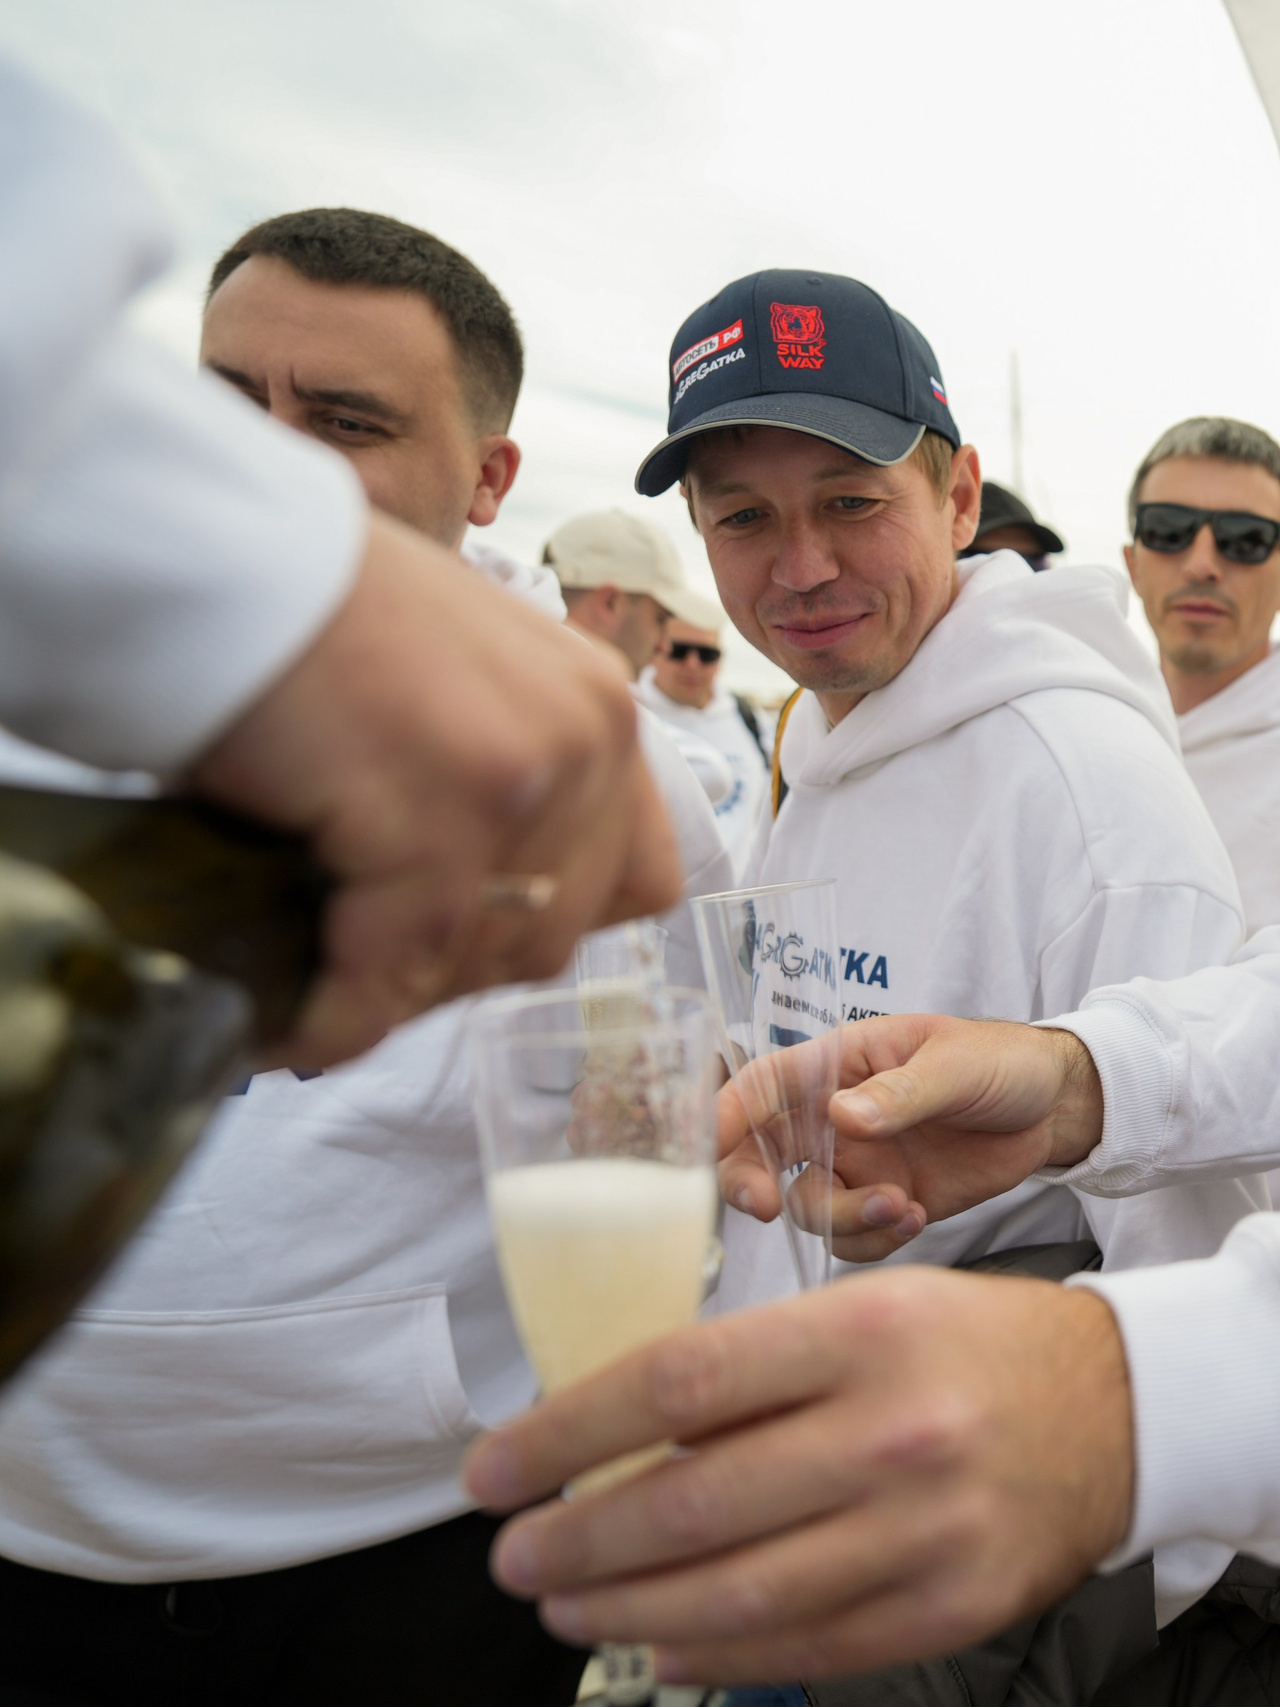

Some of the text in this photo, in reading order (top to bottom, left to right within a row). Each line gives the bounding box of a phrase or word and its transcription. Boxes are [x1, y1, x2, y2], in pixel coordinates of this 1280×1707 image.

[723, 327, 741, 344] РФ
[777, 344, 824, 357] SILK
[778, 356, 824, 369] WAY
